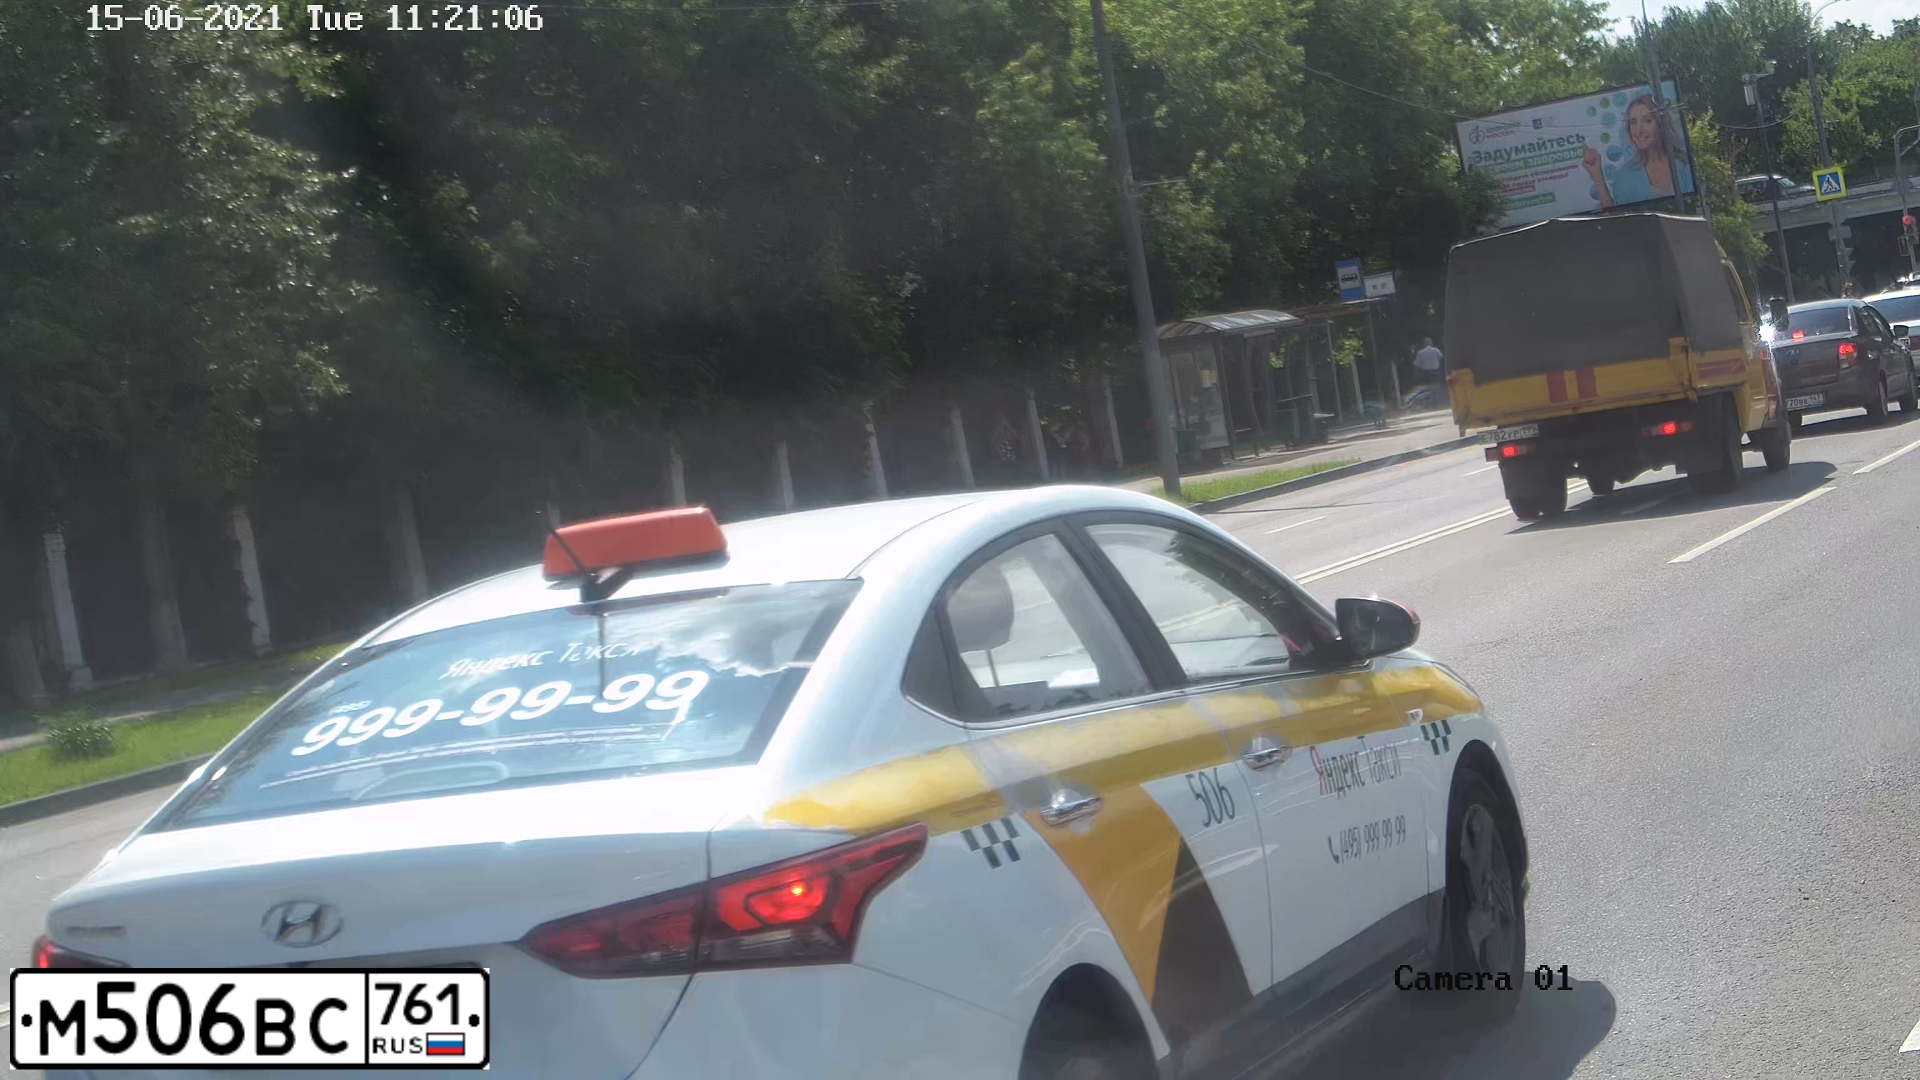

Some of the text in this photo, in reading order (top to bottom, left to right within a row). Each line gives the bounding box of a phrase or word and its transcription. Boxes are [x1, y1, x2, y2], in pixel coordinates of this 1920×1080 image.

[1472, 132, 1586, 164] Задумайтесь
[438, 650, 554, 680] Яндекс
[291, 669, 710, 756] 999-99-99
[1185, 766, 1236, 829] 506
[1309, 745, 1366, 800] Яндекс
[1339, 814, 1406, 865] (495) 999 99 99
